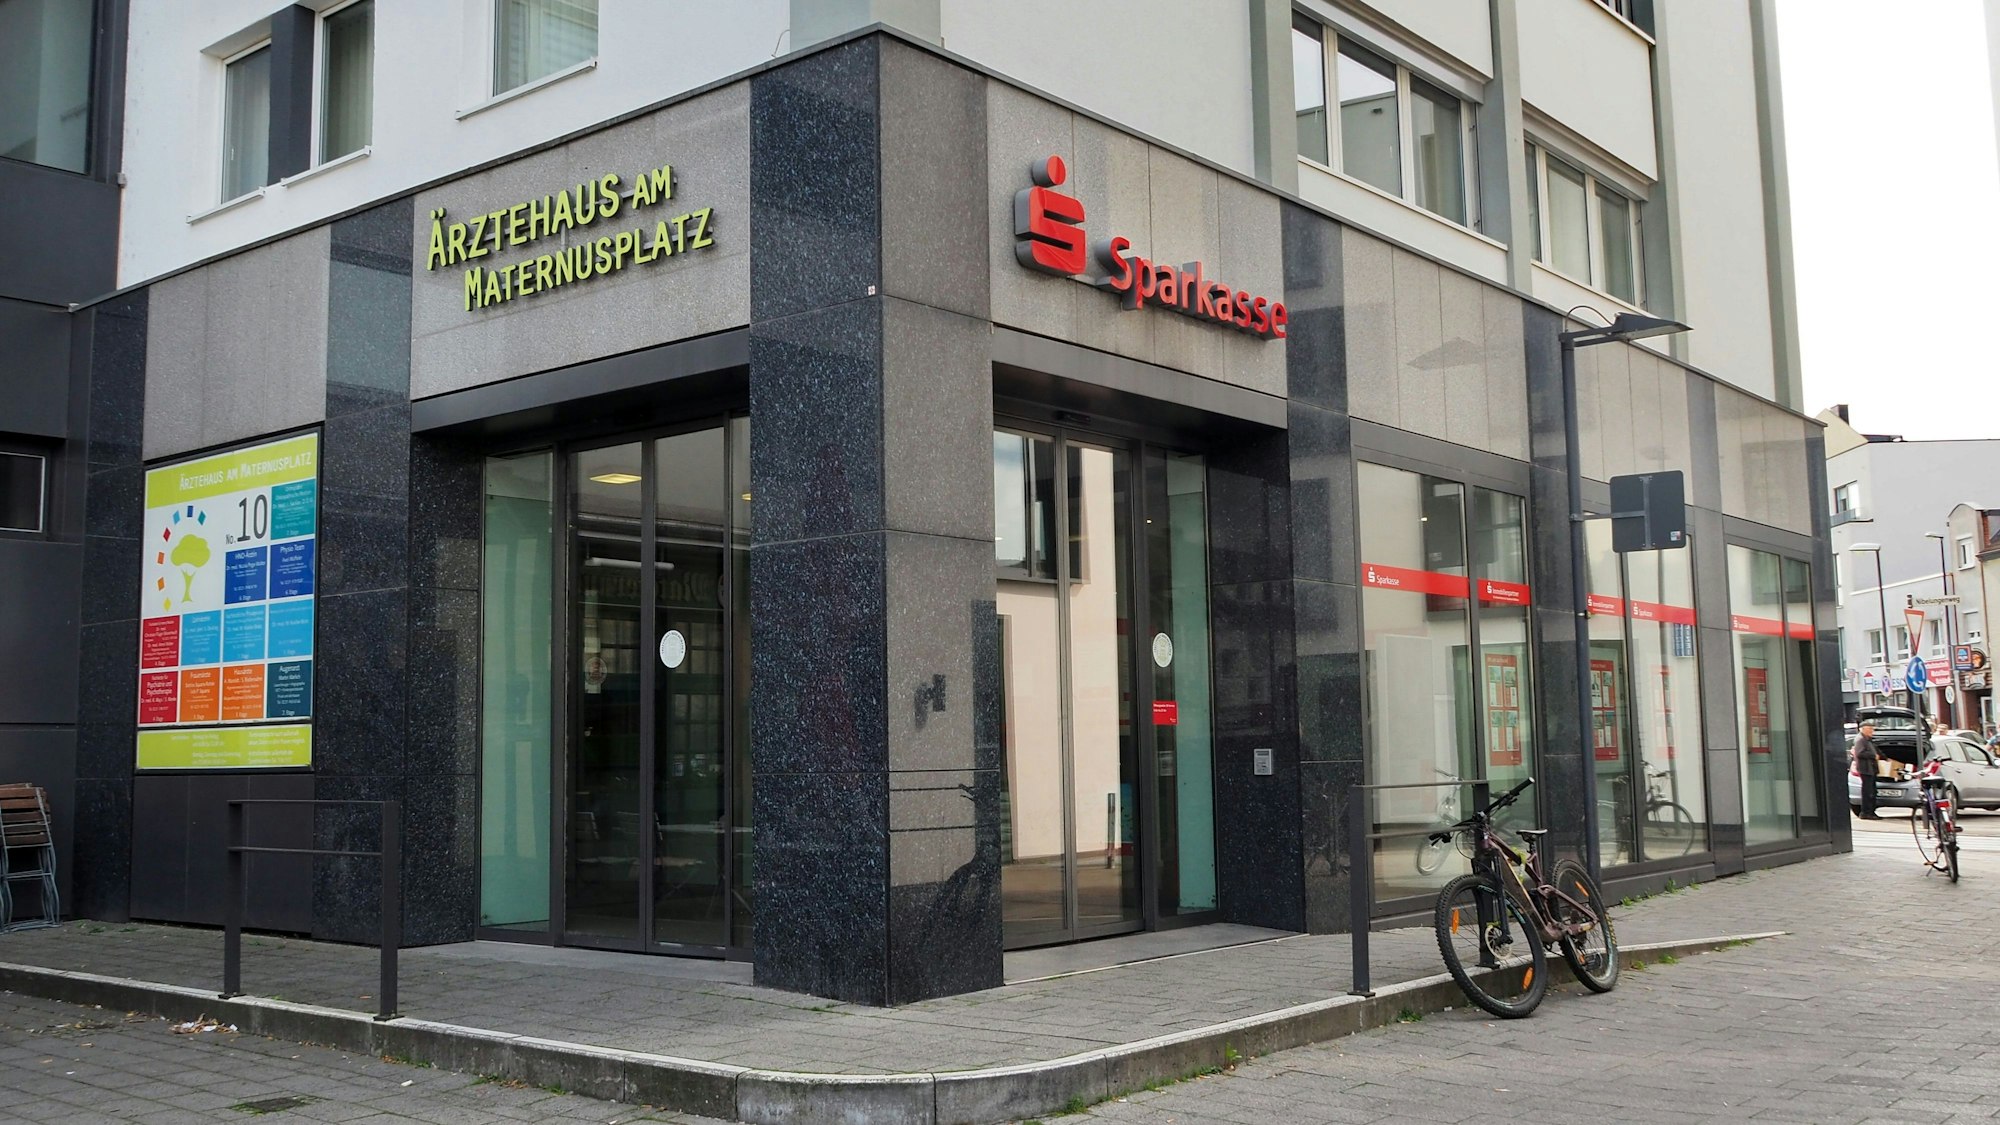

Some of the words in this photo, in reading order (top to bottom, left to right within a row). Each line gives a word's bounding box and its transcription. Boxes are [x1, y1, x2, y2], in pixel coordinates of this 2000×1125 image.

[426, 173, 621, 271] ÄRZTEHAUS
[632, 164, 674, 210] AM
[464, 207, 714, 311] MATERNUSPLATZ
[1106, 235, 1289, 339] Sparkasse
[240, 451, 313, 478] MATERNUSPLATZ
[237, 494, 268, 543] 10
[1376, 574, 1400, 587] Sparkasse
